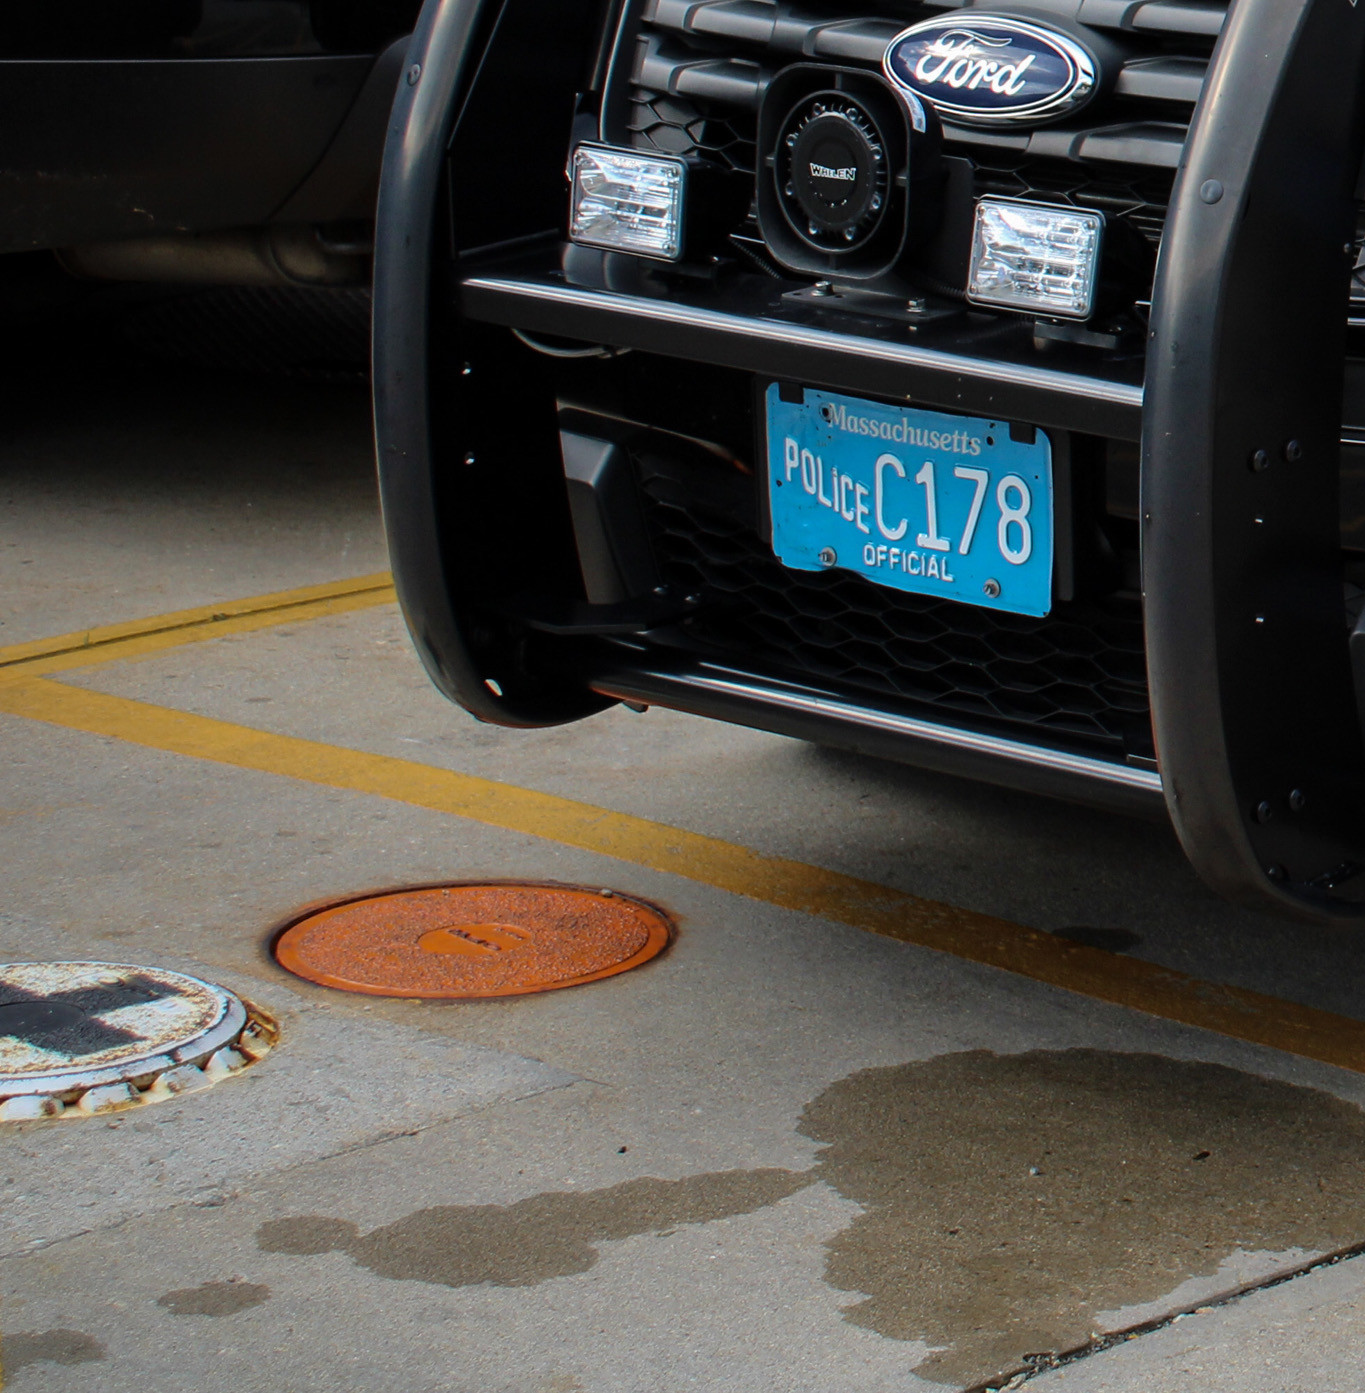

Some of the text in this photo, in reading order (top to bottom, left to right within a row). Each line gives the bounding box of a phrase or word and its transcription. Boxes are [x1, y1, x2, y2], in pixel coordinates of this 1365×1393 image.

[914, 30, 1038, 97] Ford
[828, 403, 983, 456] Massachusetts
[784, 436, 1033, 566] POLICE C178
[863, 541, 955, 582] OFFICIAL
